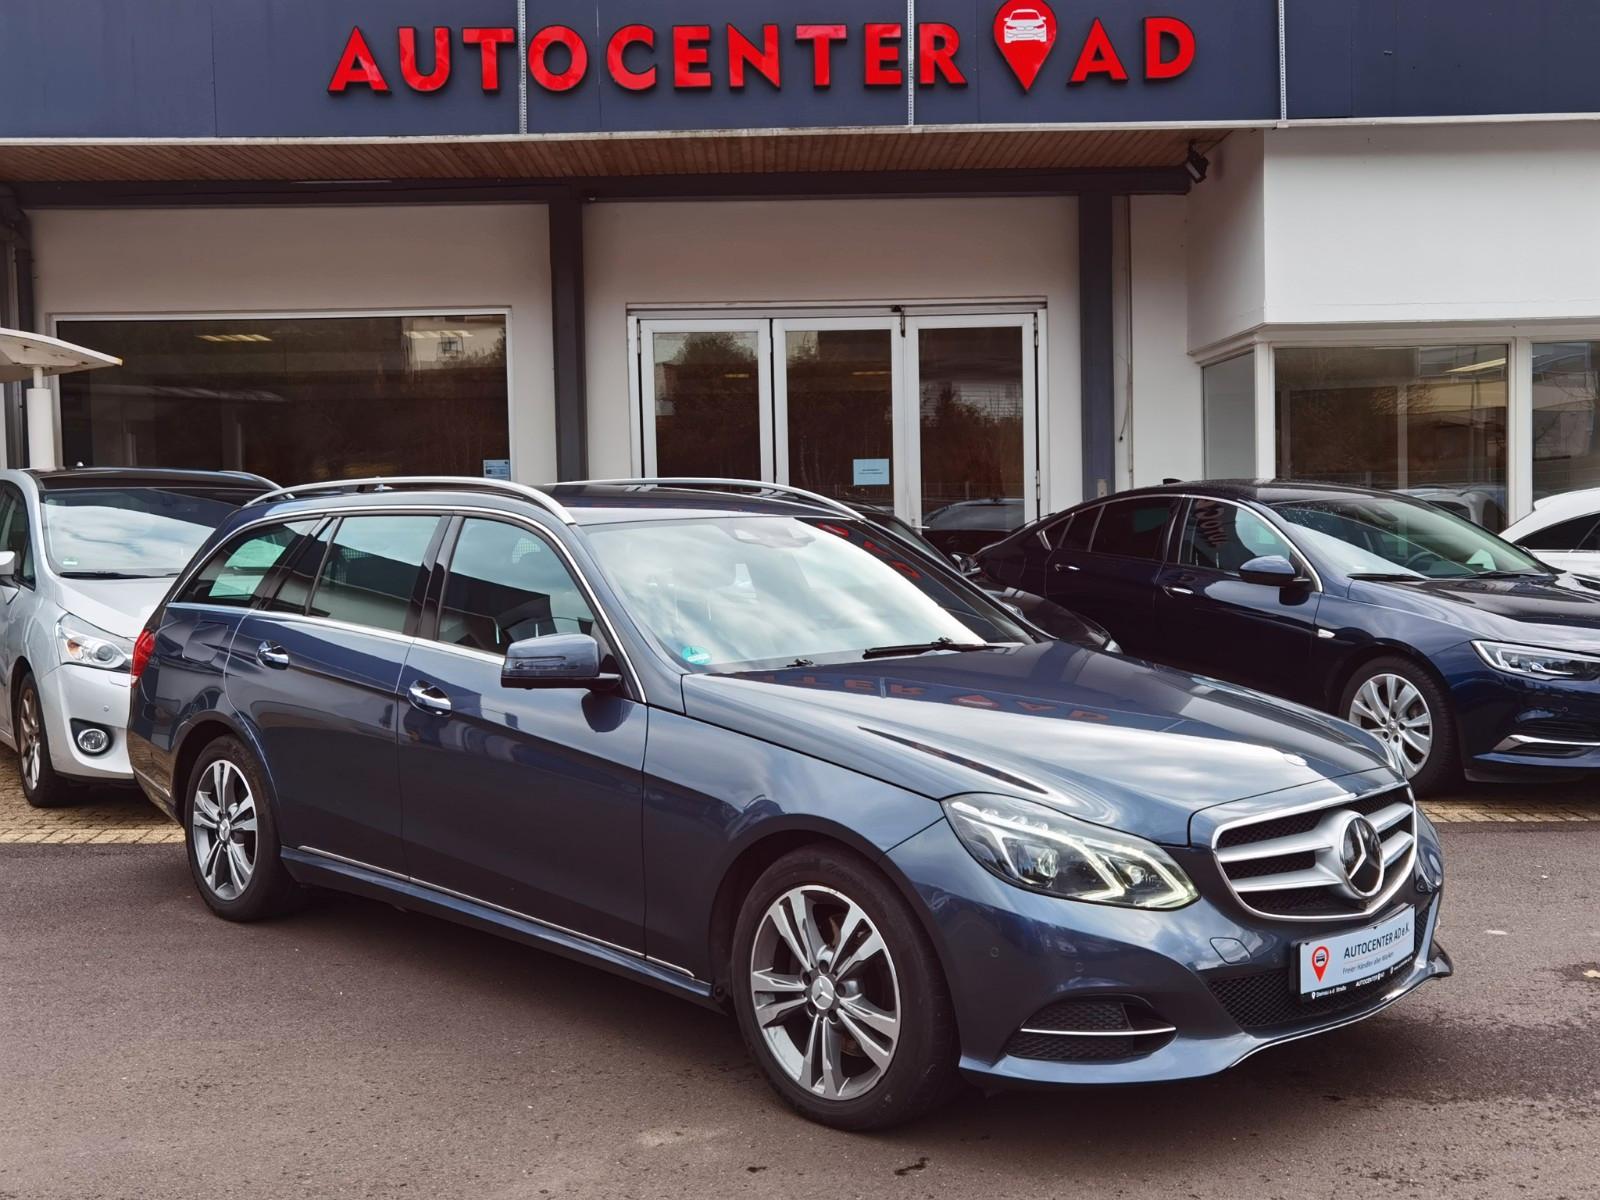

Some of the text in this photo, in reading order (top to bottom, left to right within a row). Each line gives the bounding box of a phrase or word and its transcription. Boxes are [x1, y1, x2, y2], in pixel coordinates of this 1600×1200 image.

[327, 15, 1196, 95] AUTOCENTER AD
[1344, 932, 1393, 959] AUTOCENTER
[1393, 929, 1401, 942] AD
